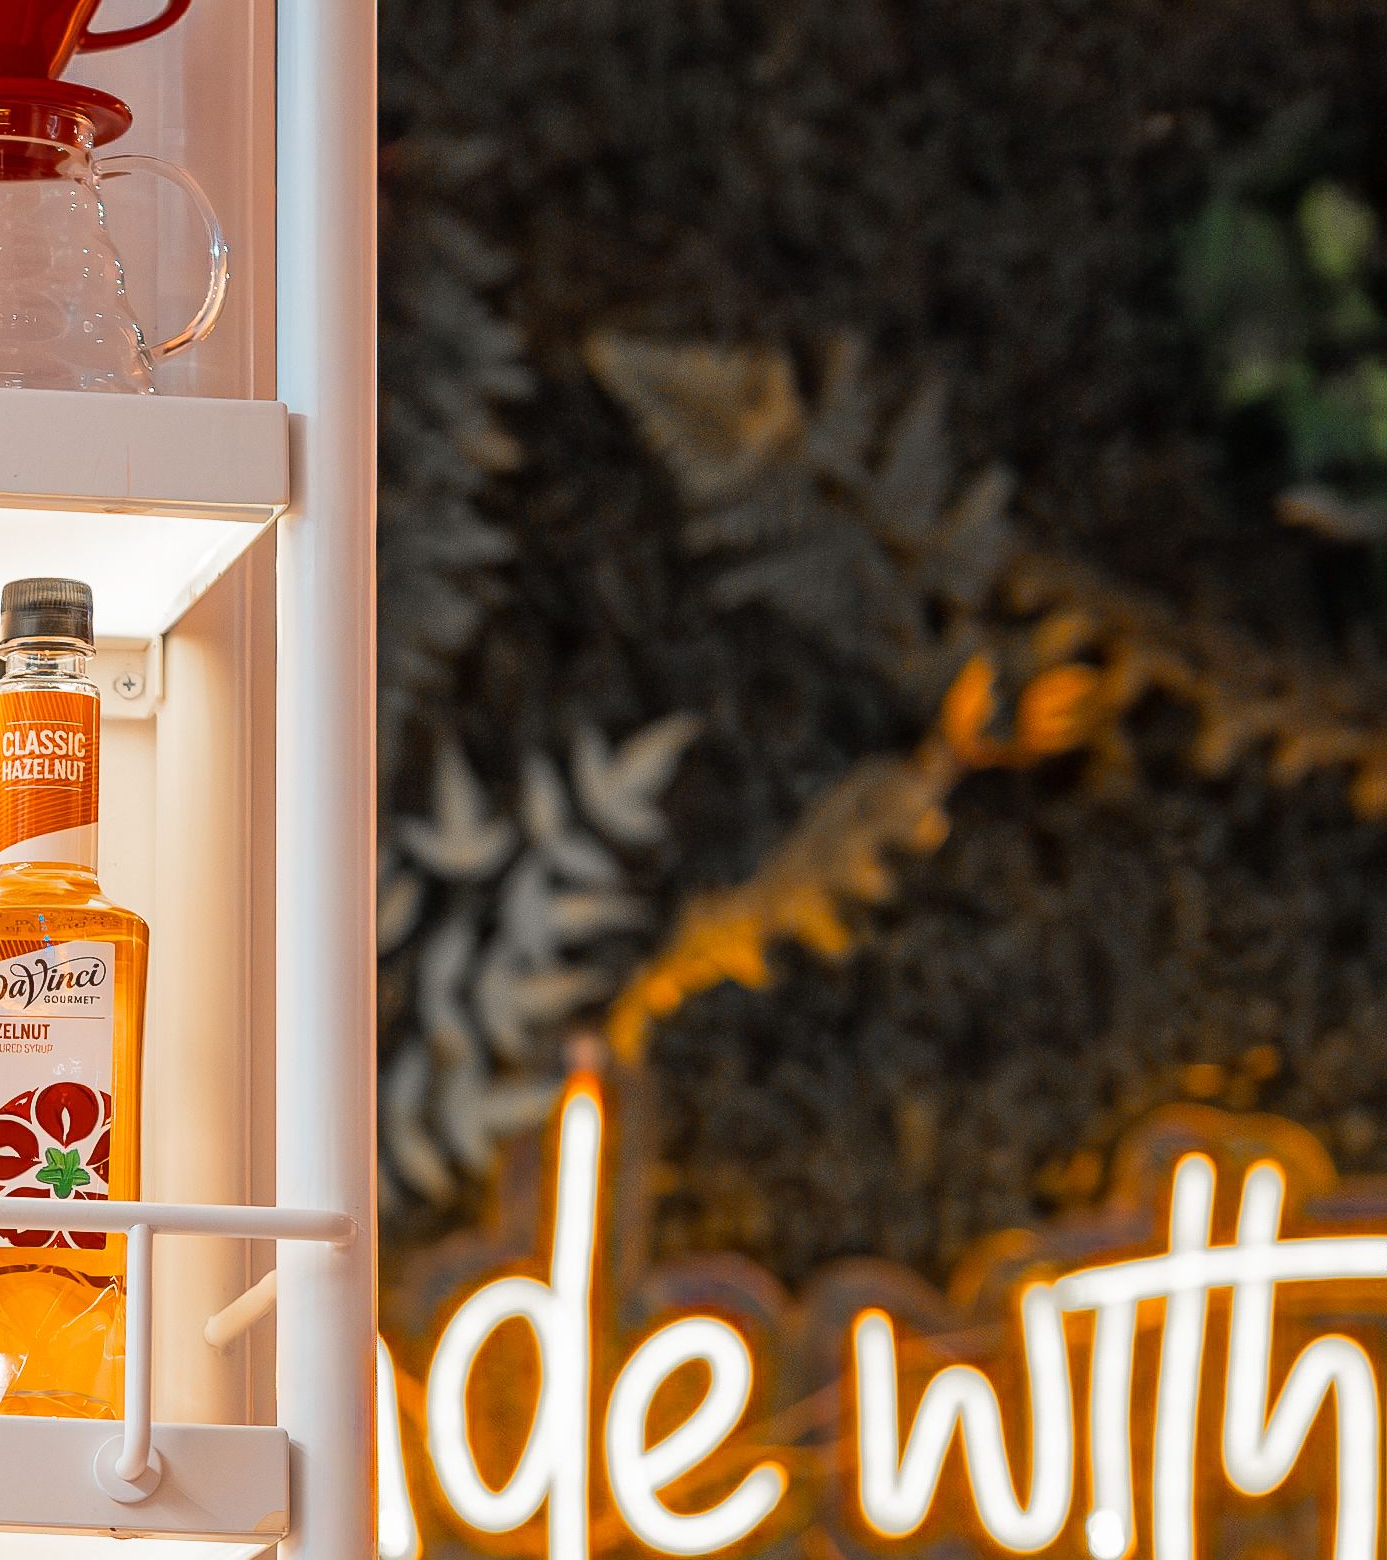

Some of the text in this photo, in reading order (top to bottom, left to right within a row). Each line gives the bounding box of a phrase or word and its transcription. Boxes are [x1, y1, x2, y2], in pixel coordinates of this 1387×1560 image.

[2, 729, 86, 758] CLASSIC
[1, 758, 86, 782] HAZELNUT
[24, 1043, 54, 1055] SYRUP
